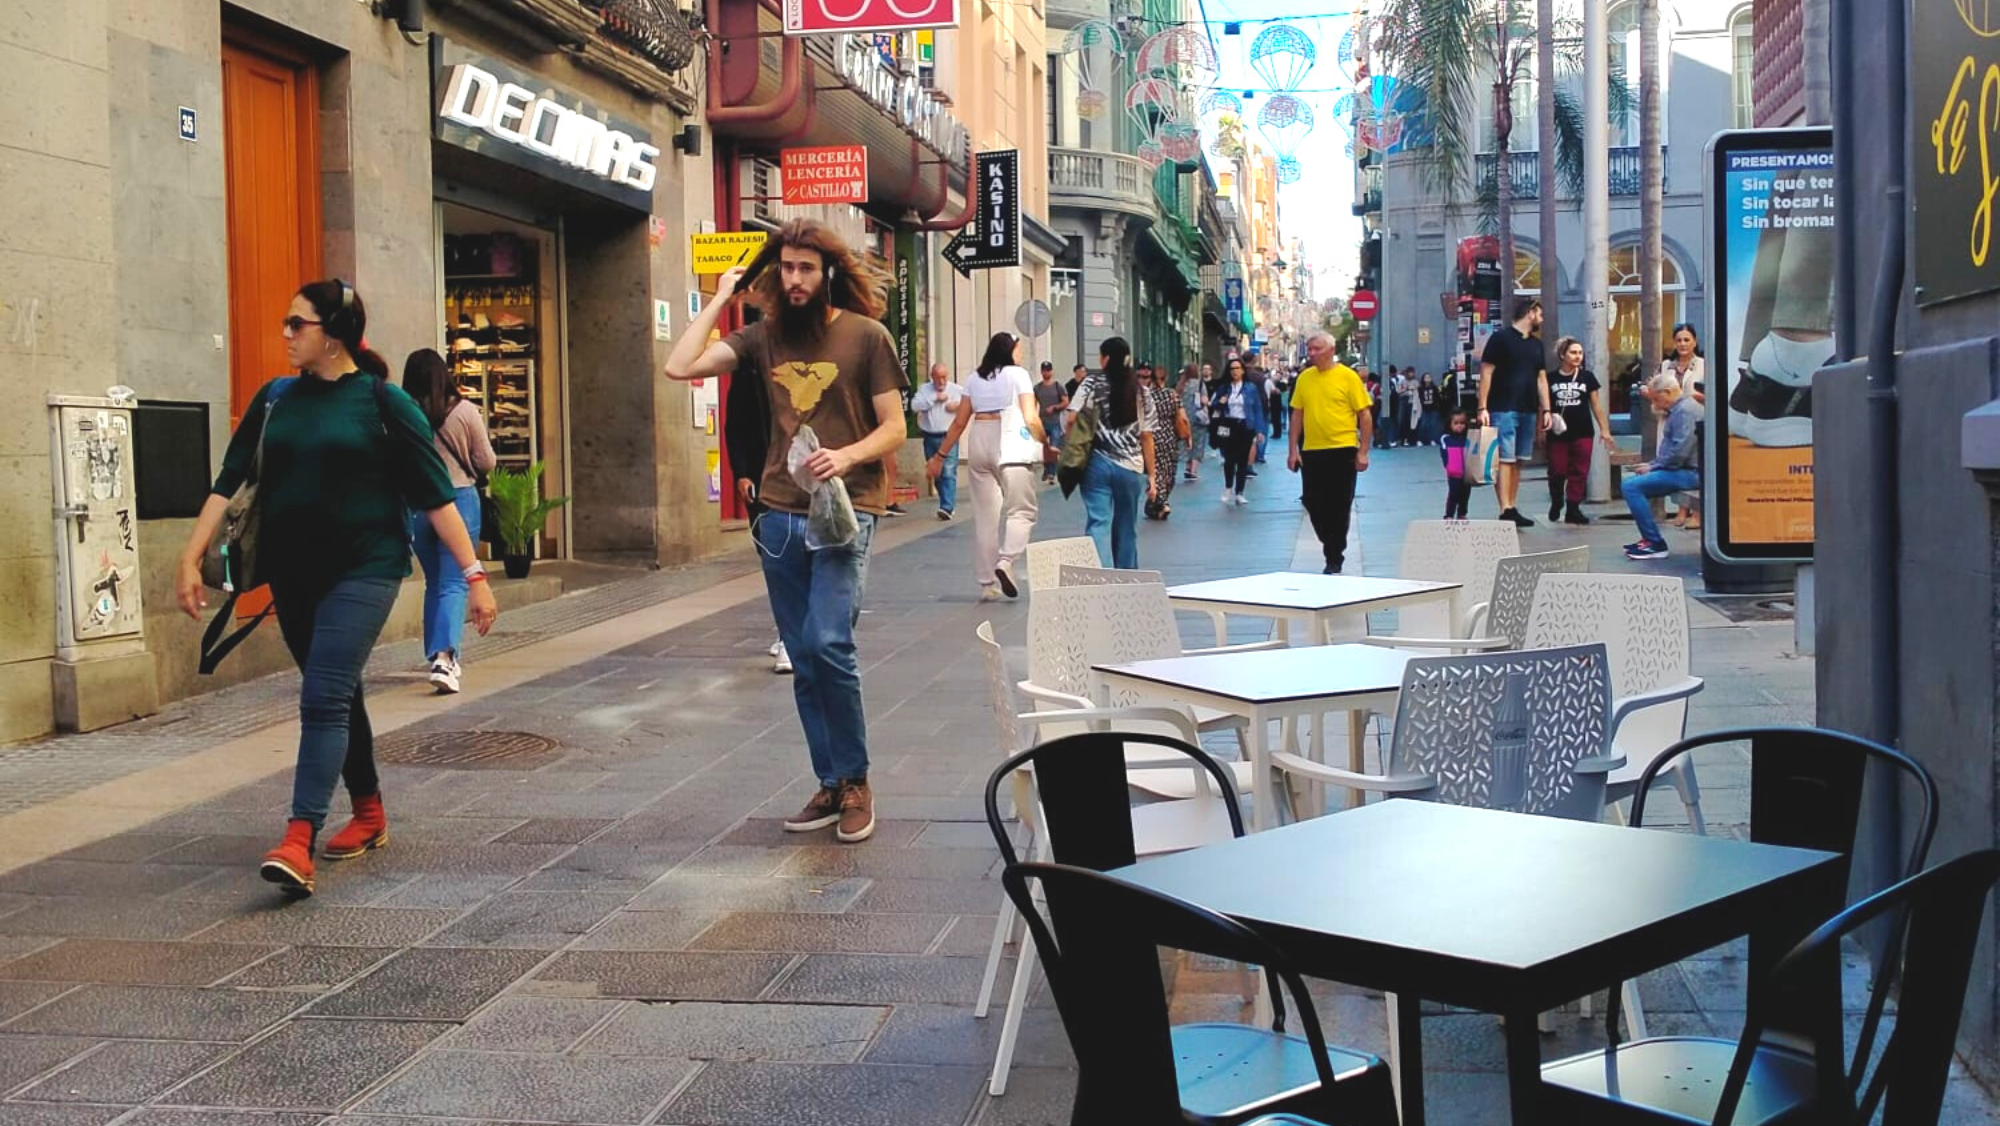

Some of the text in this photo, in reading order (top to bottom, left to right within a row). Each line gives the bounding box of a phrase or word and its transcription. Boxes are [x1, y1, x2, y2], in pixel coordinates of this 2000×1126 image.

[182, 114, 194, 134] 35
[786, 148, 862, 165] MERCERÍA
[788, 164, 861, 180] LENCERÍA
[800, 182, 850, 198] CASTILLO
[1742, 177, 1769, 191] Sin
[1773, 178, 1805, 193] que
[988, 163, 1004, 247] KASINO
[1742, 195, 1769, 210] Sin
[1773, 196, 1819, 209] tocar
[1742, 214, 1769, 228] Sin
[695, 237, 726, 245] BAZAR
[695, 254, 732, 263] TABACO
